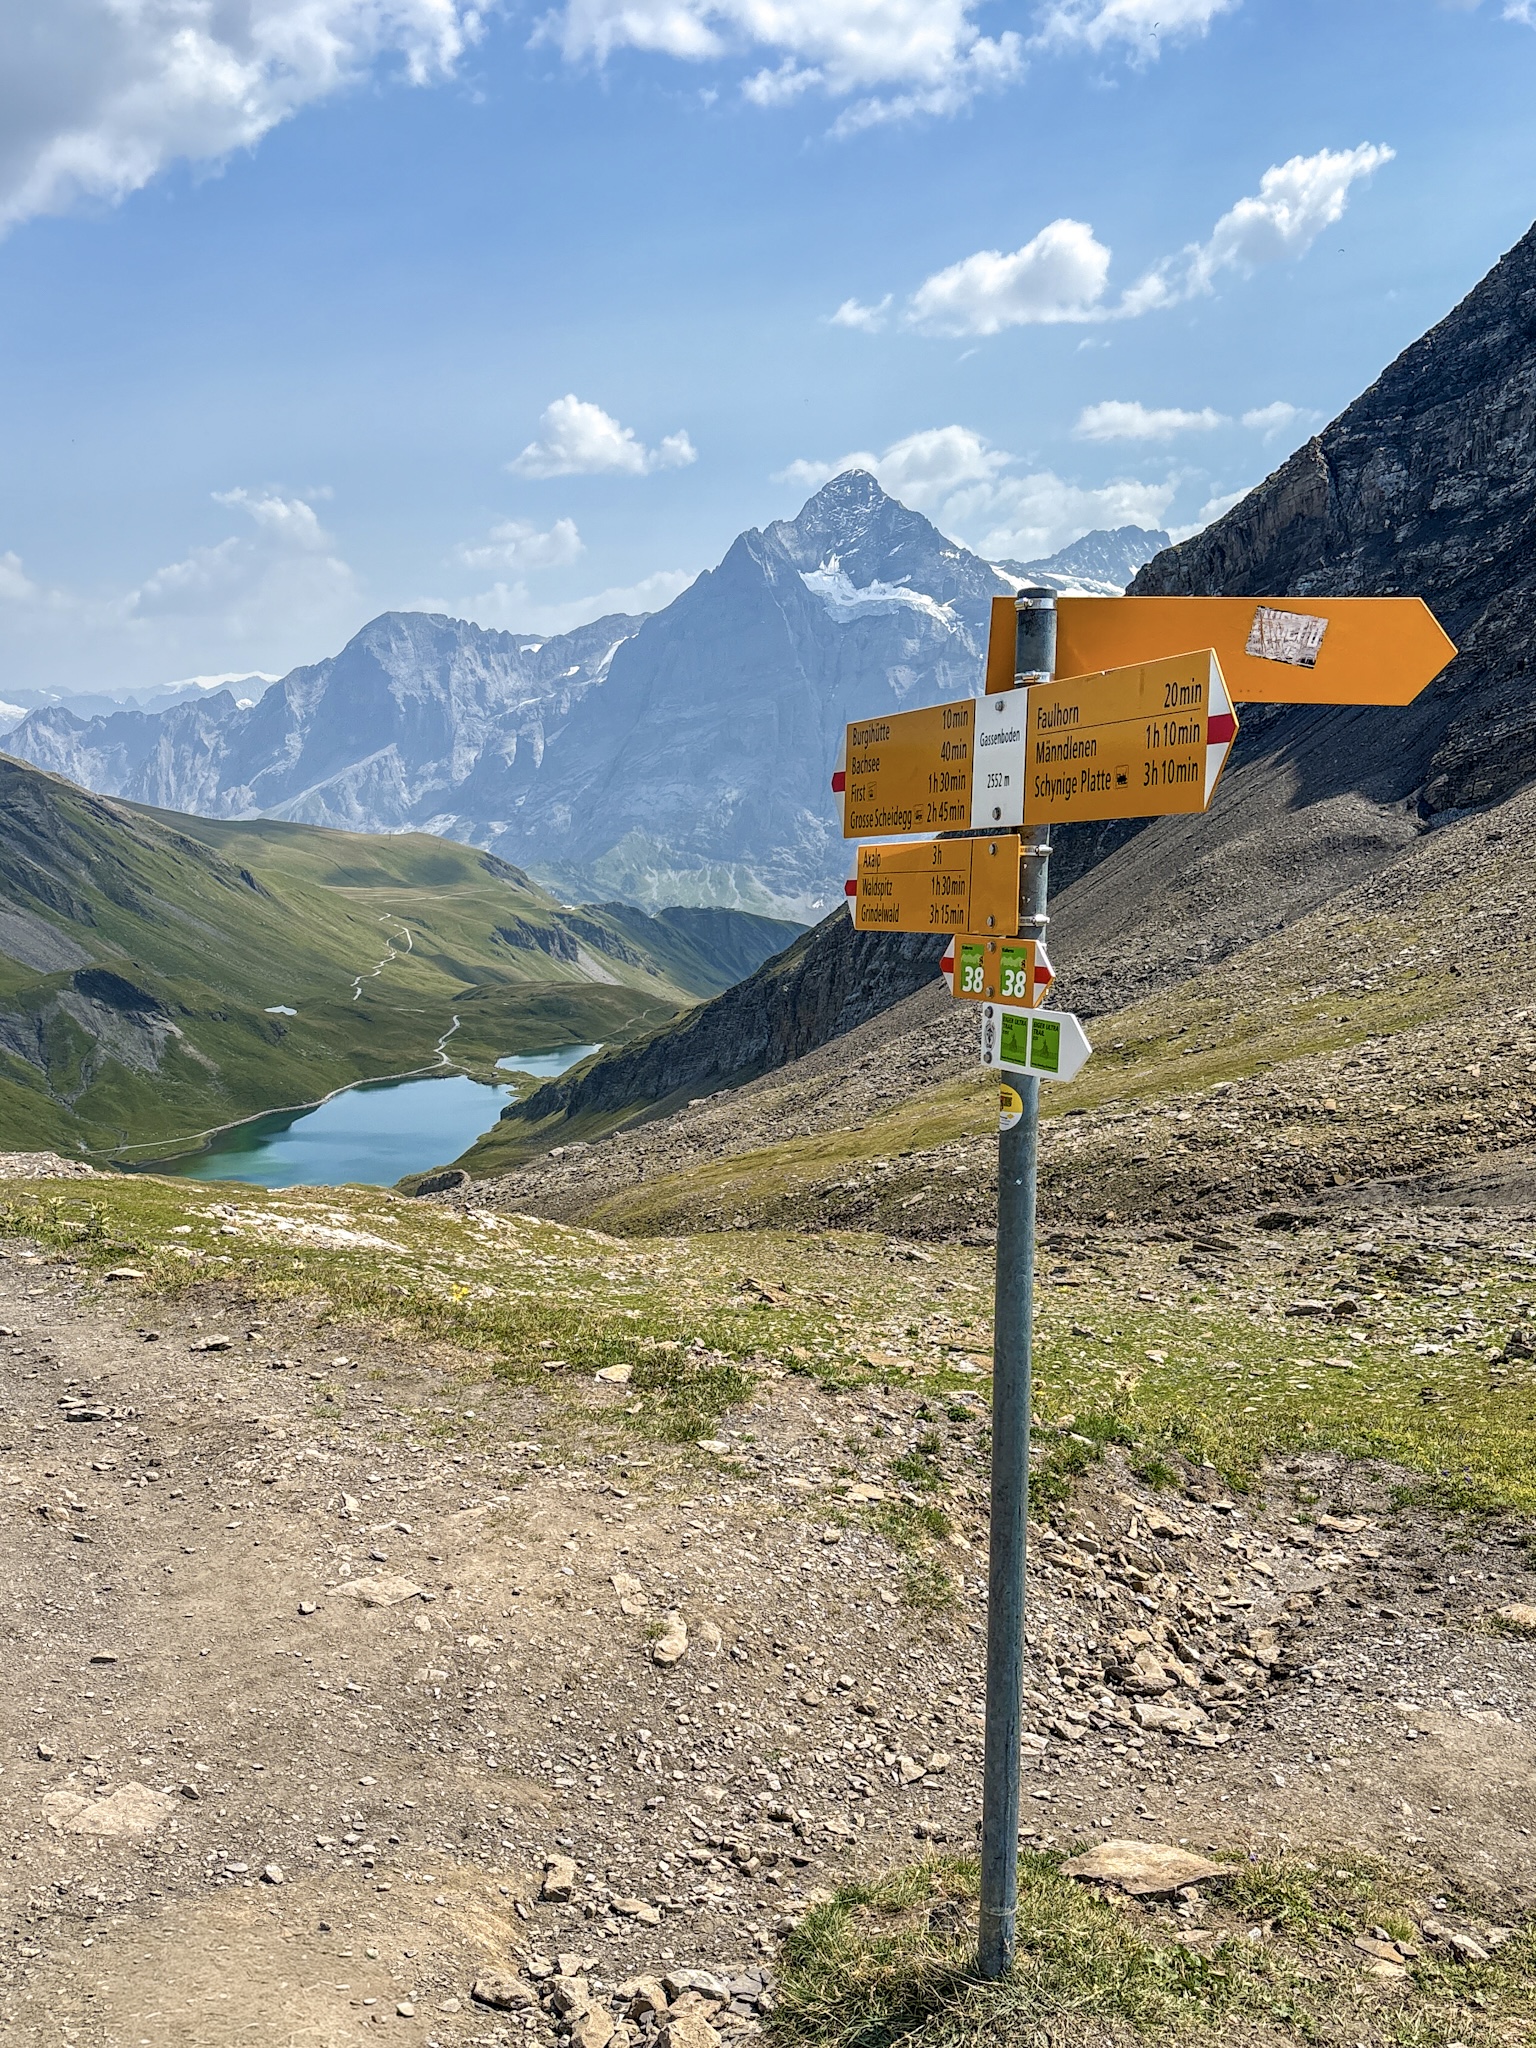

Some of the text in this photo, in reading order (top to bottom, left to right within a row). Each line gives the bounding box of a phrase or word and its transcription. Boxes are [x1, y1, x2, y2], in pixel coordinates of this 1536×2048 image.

[1165, 679, 1202, 709] 20min
[943, 706, 968, 730] 10min
[1037, 703, 1079, 729] Faulhorn
[853, 723, 890, 749] Burgihütte
[980, 729, 1021, 747] Gassenboden
[1146, 718, 1200, 749] 1h 10min
[941, 739, 967, 761] 40min
[1036, 736, 1097, 764] Männdlenen
[852, 754, 880, 775] Bachsee
[1143, 757, 1198, 786] 3h 10min
[851, 784, 865, 802] First
[929, 770, 965, 793] 1h 30min
[987, 774, 1010, 788] 2552 m
[1035, 768, 1111, 802] Schynige Platte
[851, 806, 912, 830] Grosse Scheidegg
[927, 800, 964, 822] 2h 45min
[863, 848, 881, 872] Axalp
[932, 846, 942, 865] 3h
[862, 877, 893, 901] Waldspitz
[931, 875, 965, 895] 1h 30min
[861, 903, 899, 922] Grindelwald
[930, 905, 964, 924] 3h 15min
[962, 966, 984, 993] 38
[1002, 970, 1026, 998] 38
